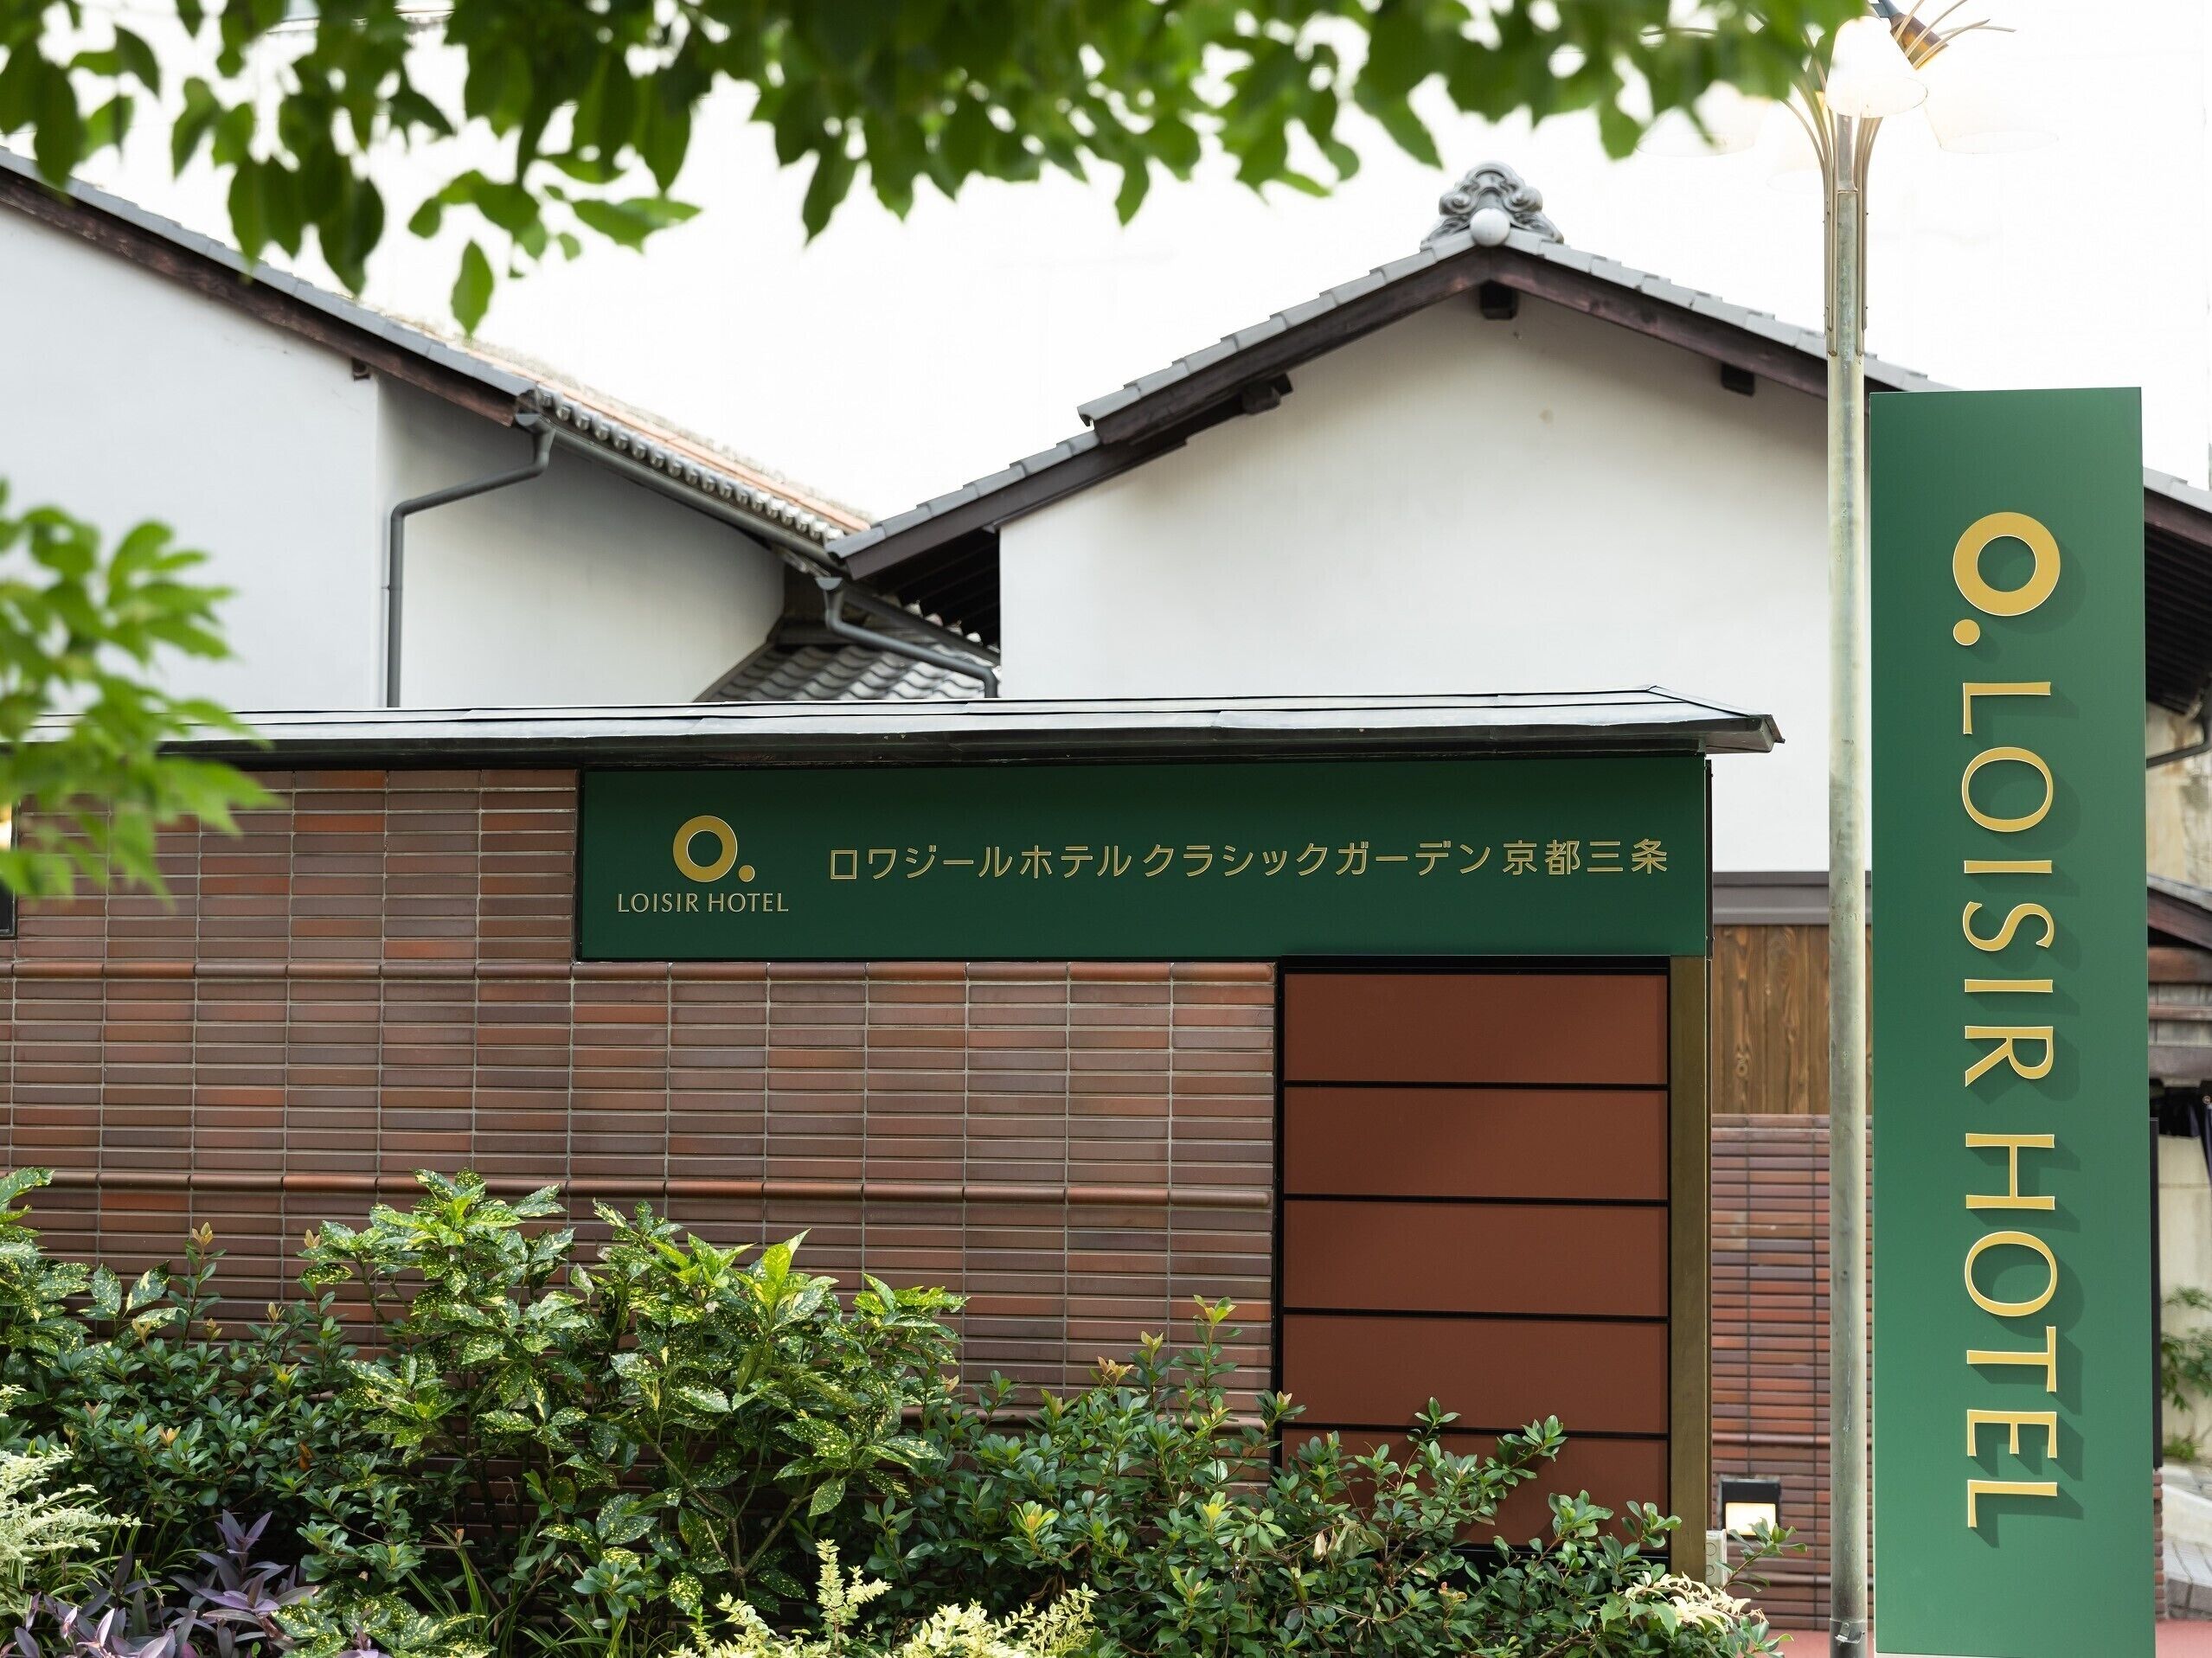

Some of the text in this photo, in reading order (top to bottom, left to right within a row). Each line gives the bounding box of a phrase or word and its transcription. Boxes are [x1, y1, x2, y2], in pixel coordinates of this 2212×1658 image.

[617, 892, 789, 913] LOISIR HOTEL
[1961, 681, 2055, 1088] LOISIR
[1963, 1131, 2060, 1529] HOTEL
